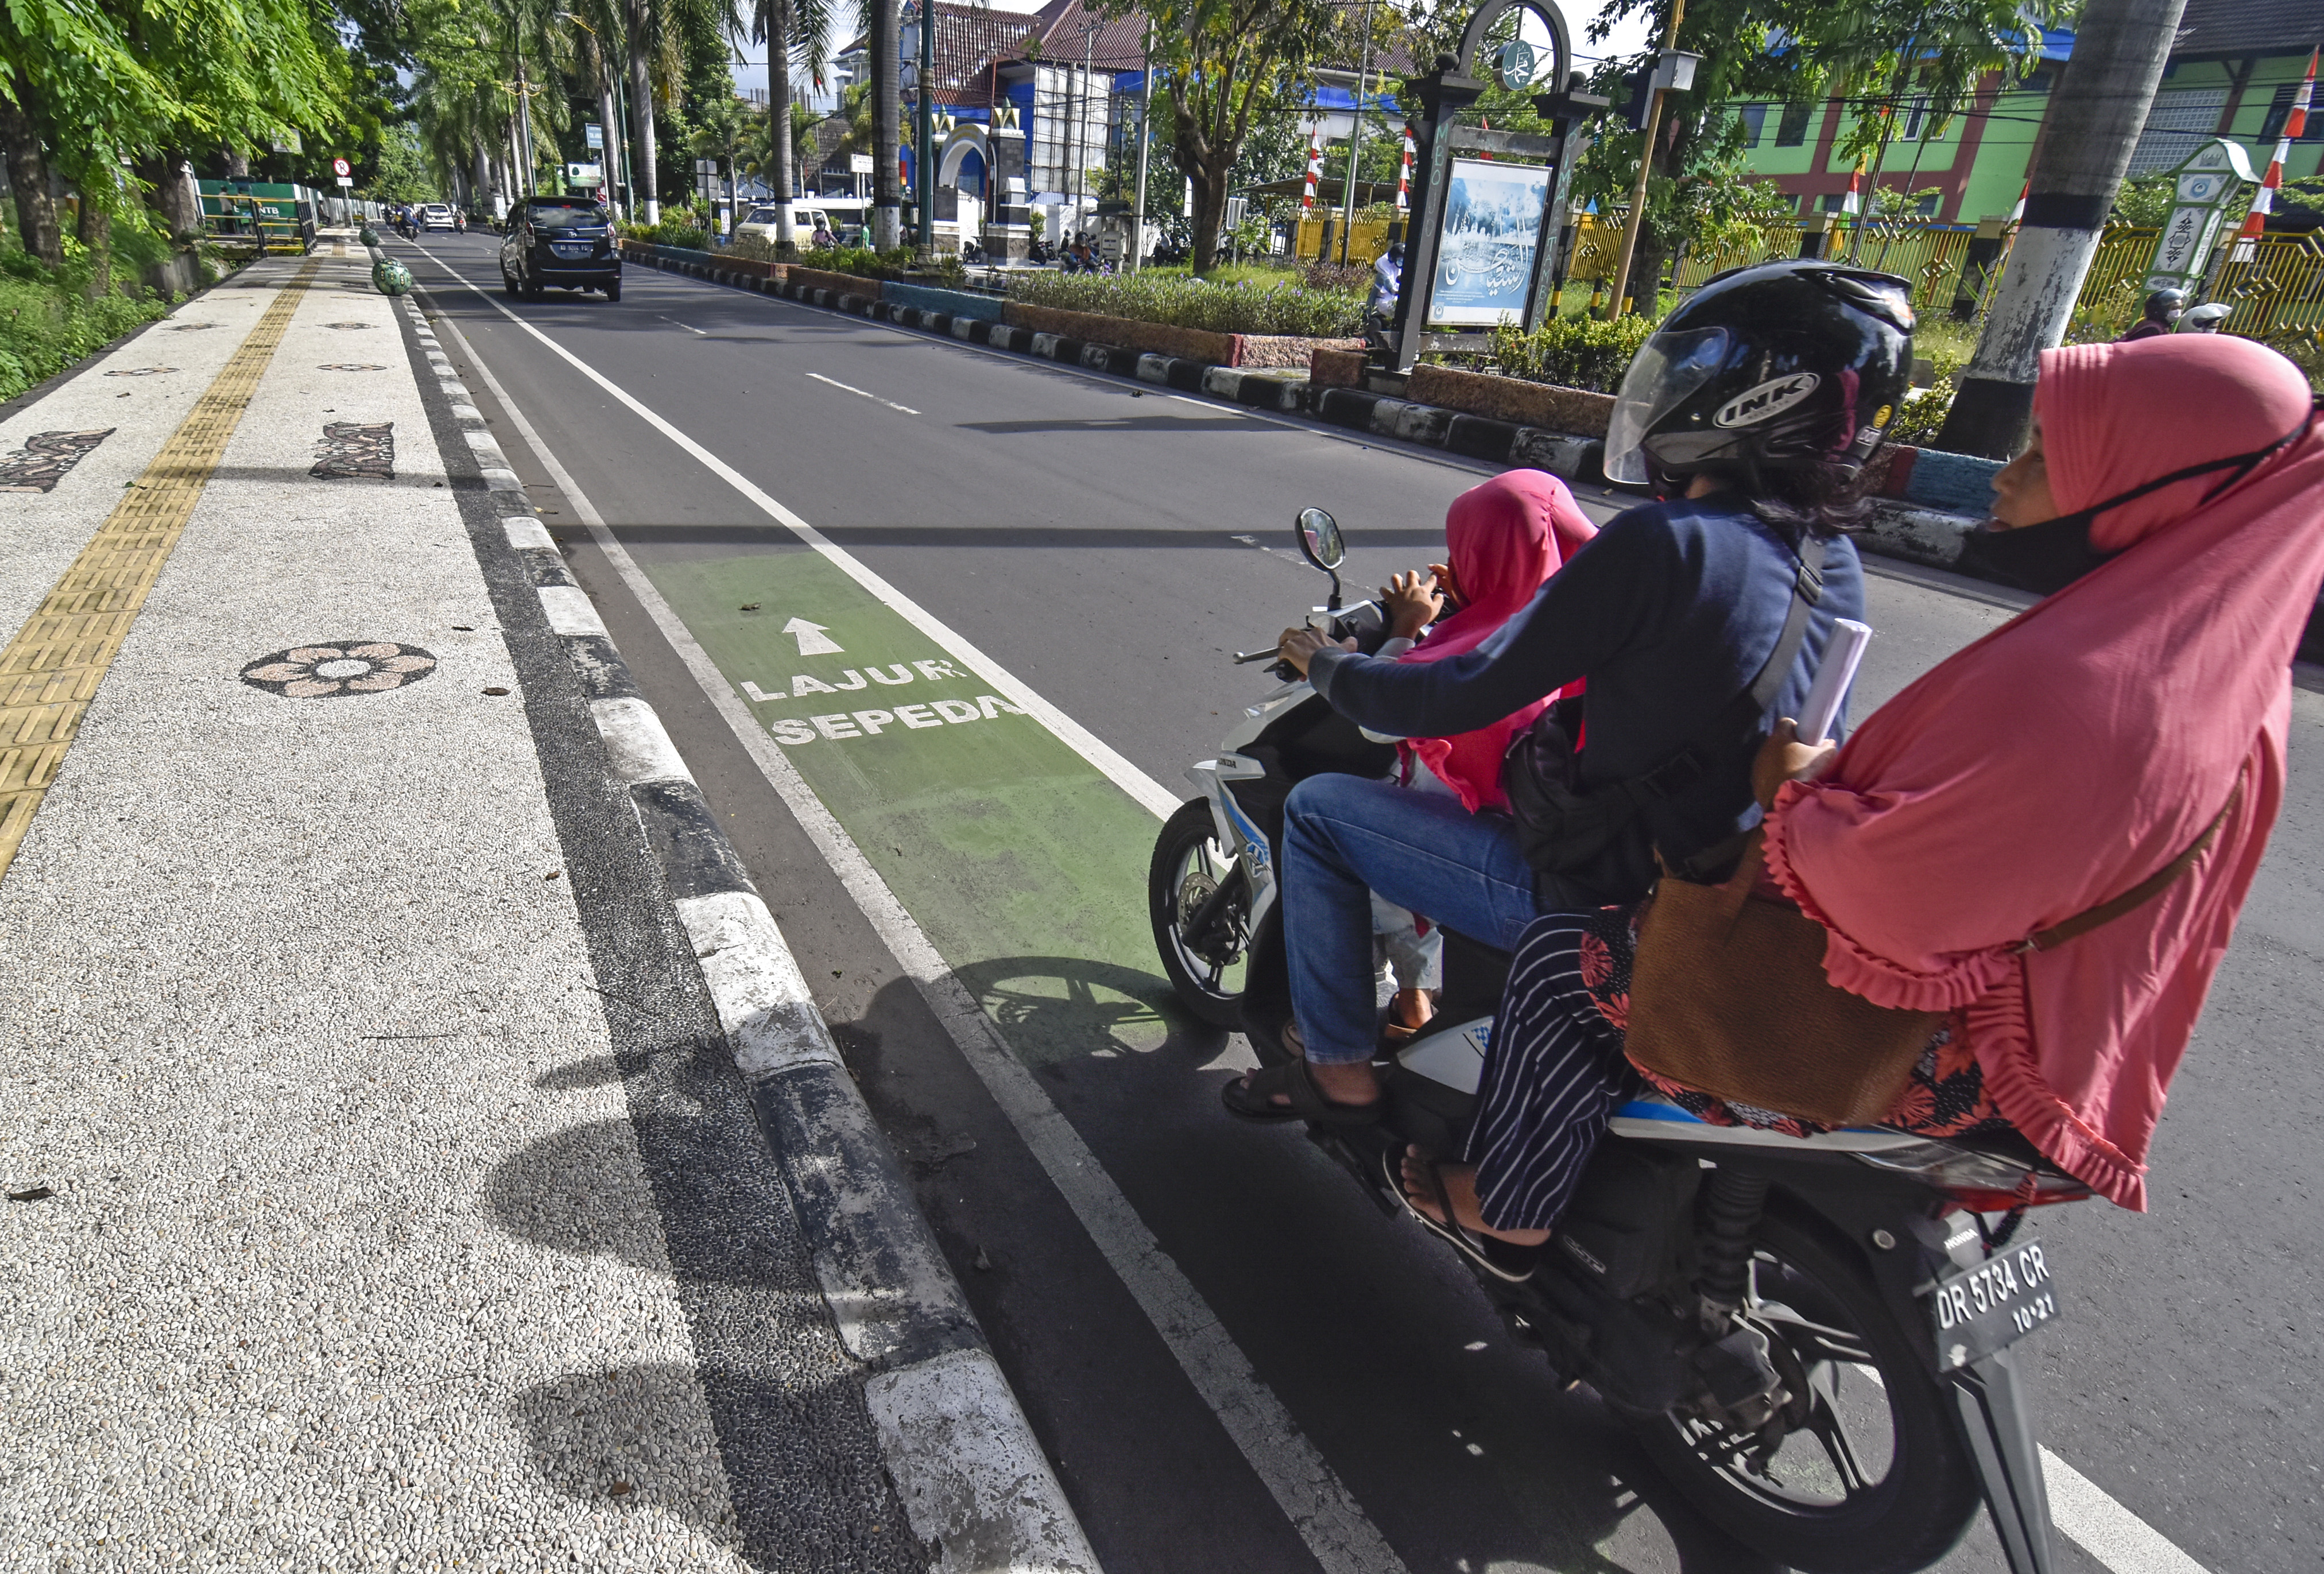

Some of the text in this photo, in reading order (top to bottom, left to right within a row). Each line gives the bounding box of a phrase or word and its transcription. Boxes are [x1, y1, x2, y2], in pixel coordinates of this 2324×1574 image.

[1725, 376, 1805, 422] INK
[739, 658, 967, 702] LAJUR
[771, 695, 1027, 745] SEPEDA
[1217, 758, 1237, 768] ONDA
[1943, 1228, 1978, 1250] HONDA
[1936, 1245, 2050, 1329] DR 5734 CR
